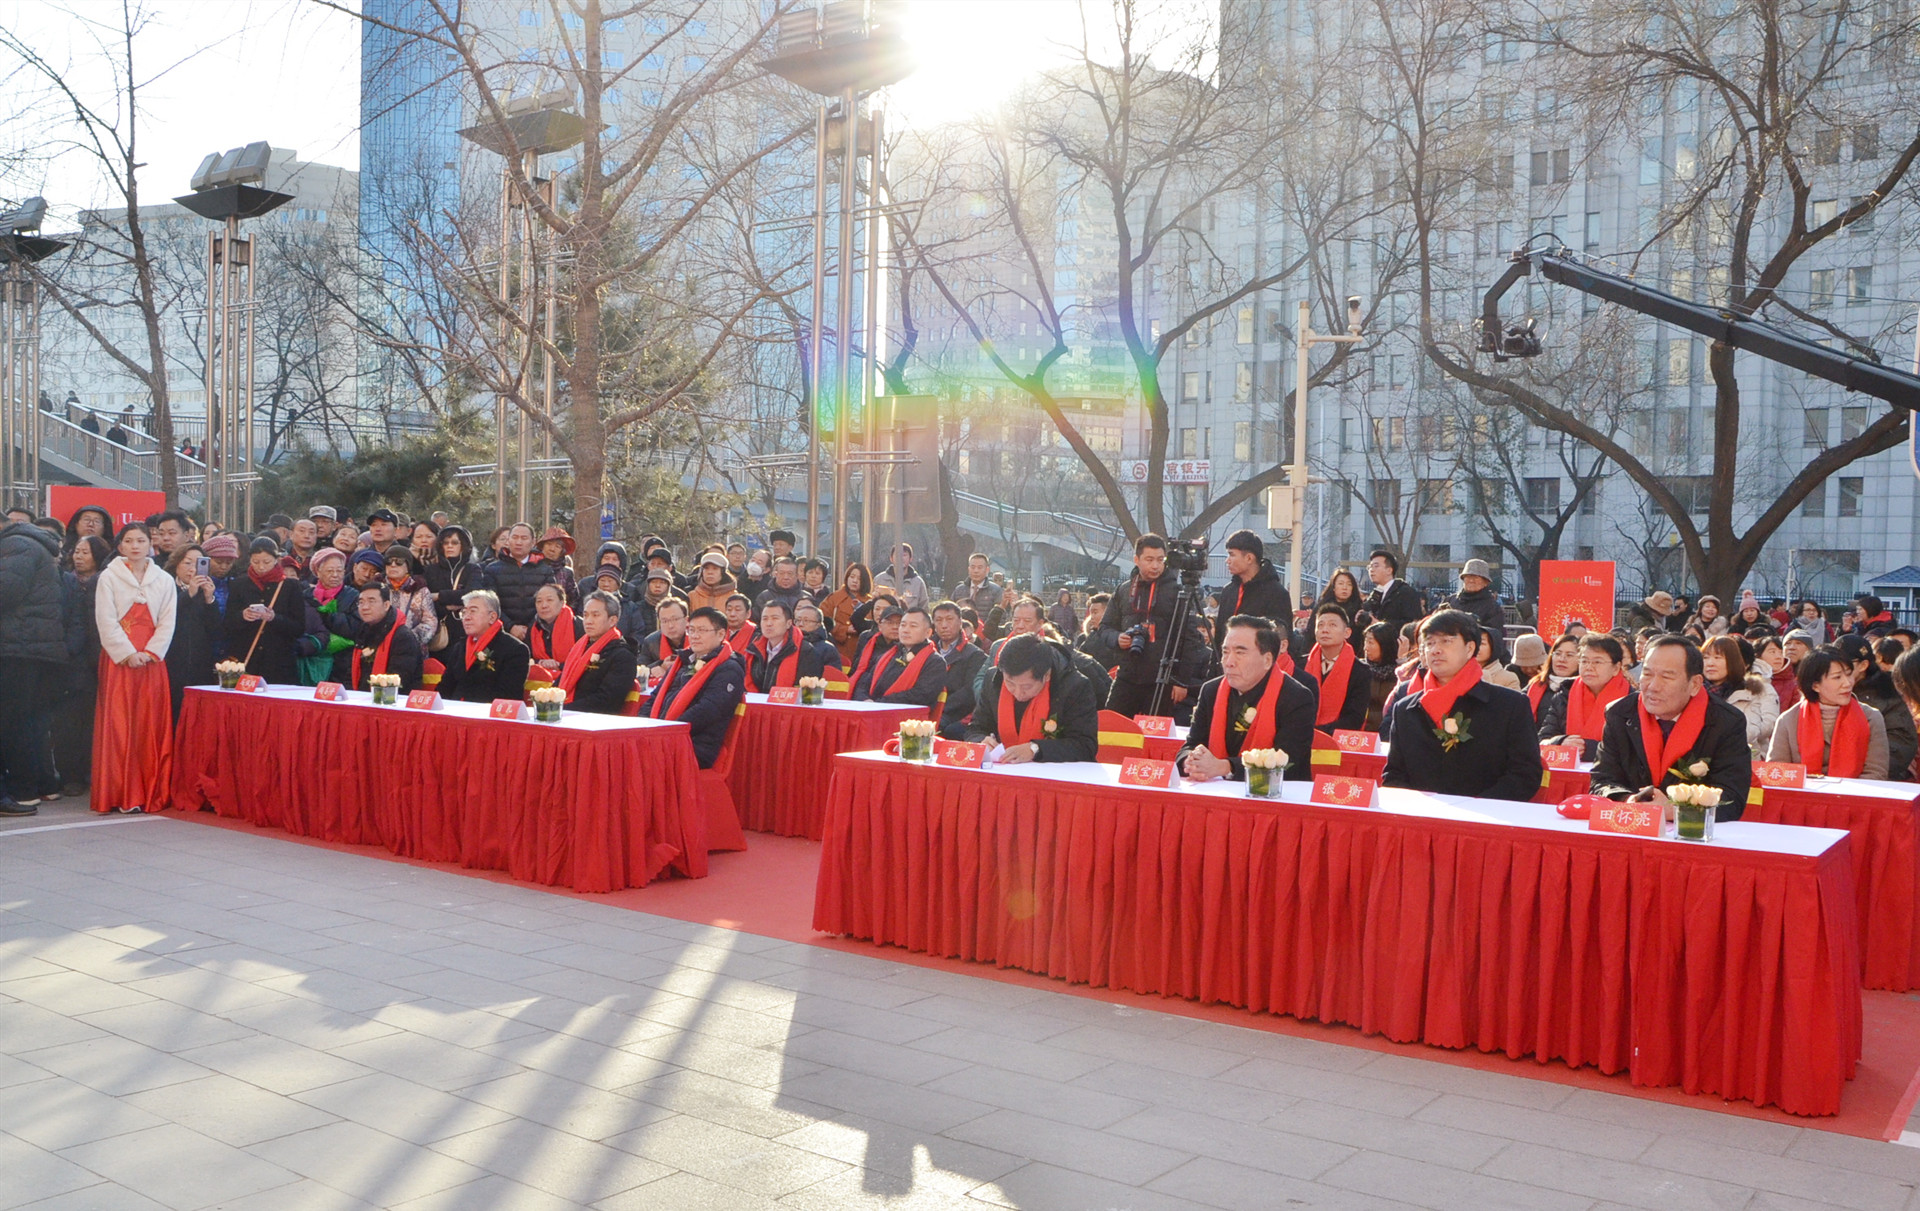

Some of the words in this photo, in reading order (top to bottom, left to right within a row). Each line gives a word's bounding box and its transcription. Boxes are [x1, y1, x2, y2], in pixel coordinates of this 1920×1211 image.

[1166, 462, 1210, 474] 京银行
[1600, 808, 1652, 827] 田怀亮
